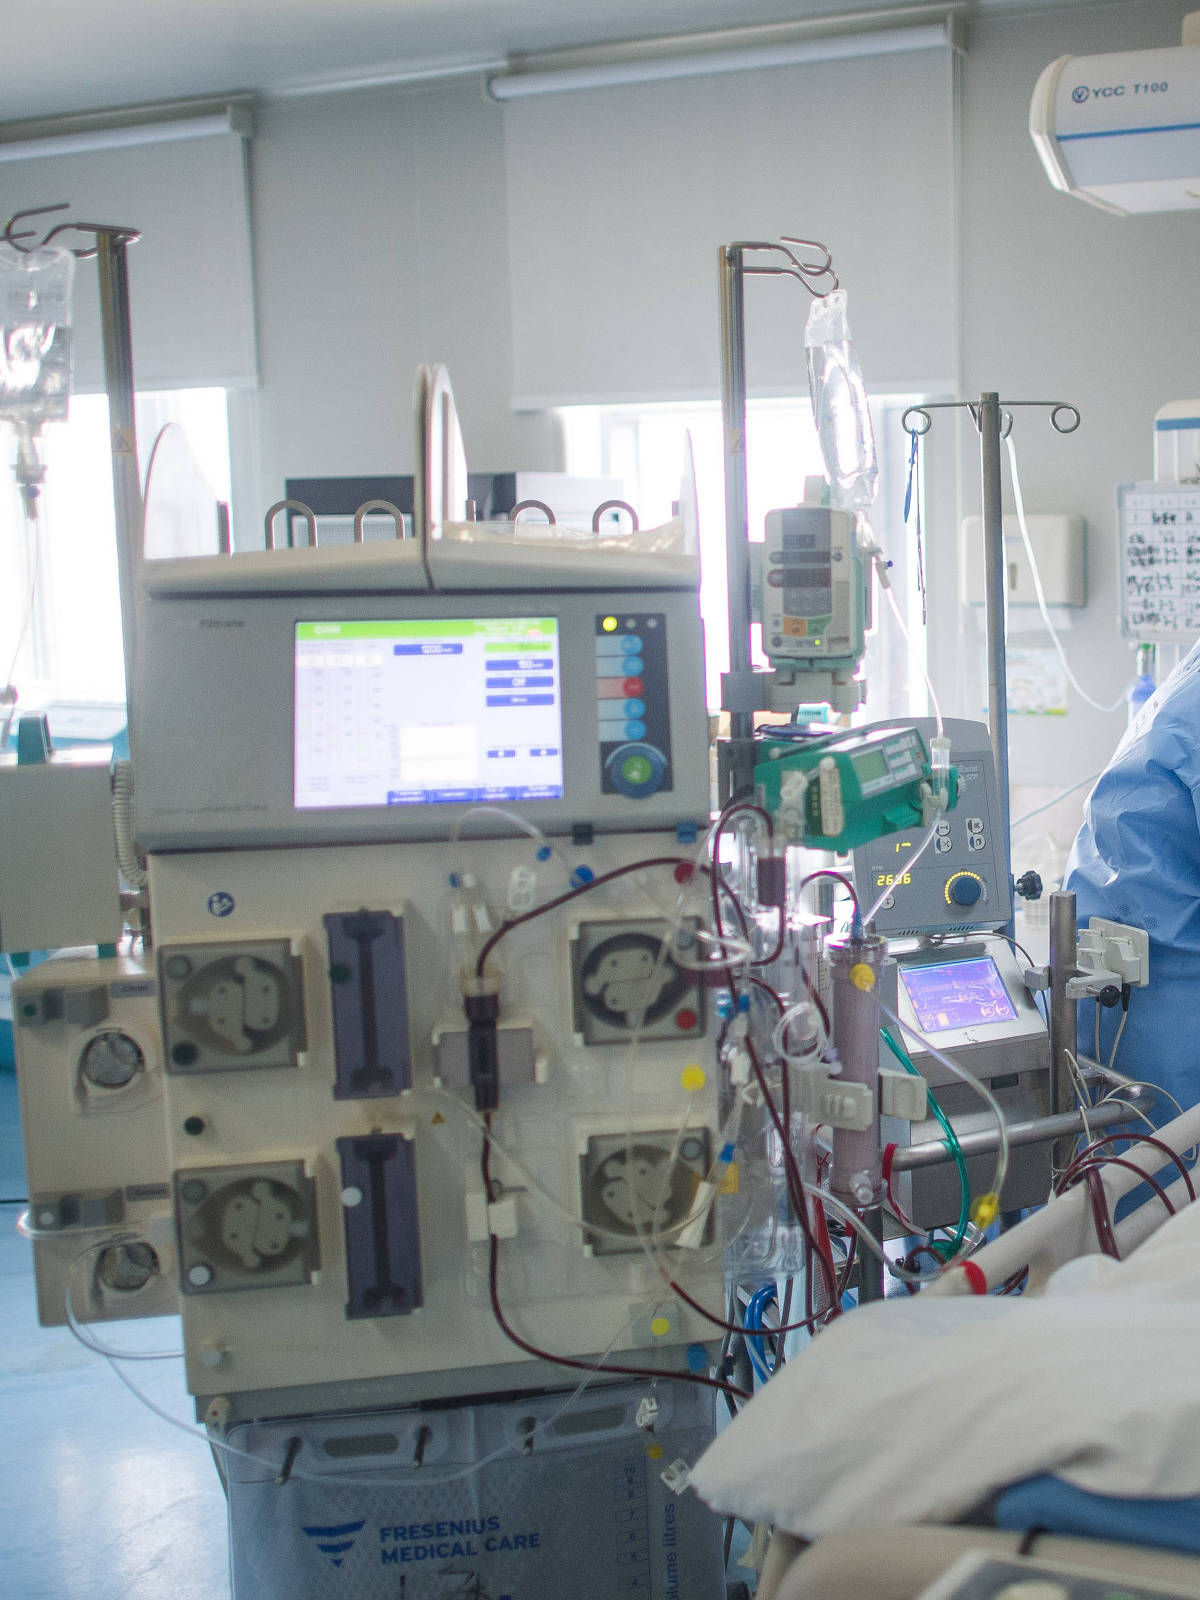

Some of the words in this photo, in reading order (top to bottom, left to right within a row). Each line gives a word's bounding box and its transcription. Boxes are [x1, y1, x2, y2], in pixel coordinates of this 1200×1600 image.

[1091, 86, 1125, 98] YCC
[1133, 81, 1169, 95] T100
[379, 1516, 500, 1543] FRESENIUS
[662, 1503, 677, 1547] litres
[380, 1541, 478, 1565] MEDICAL
[485, 1532, 541, 1552] CARE
